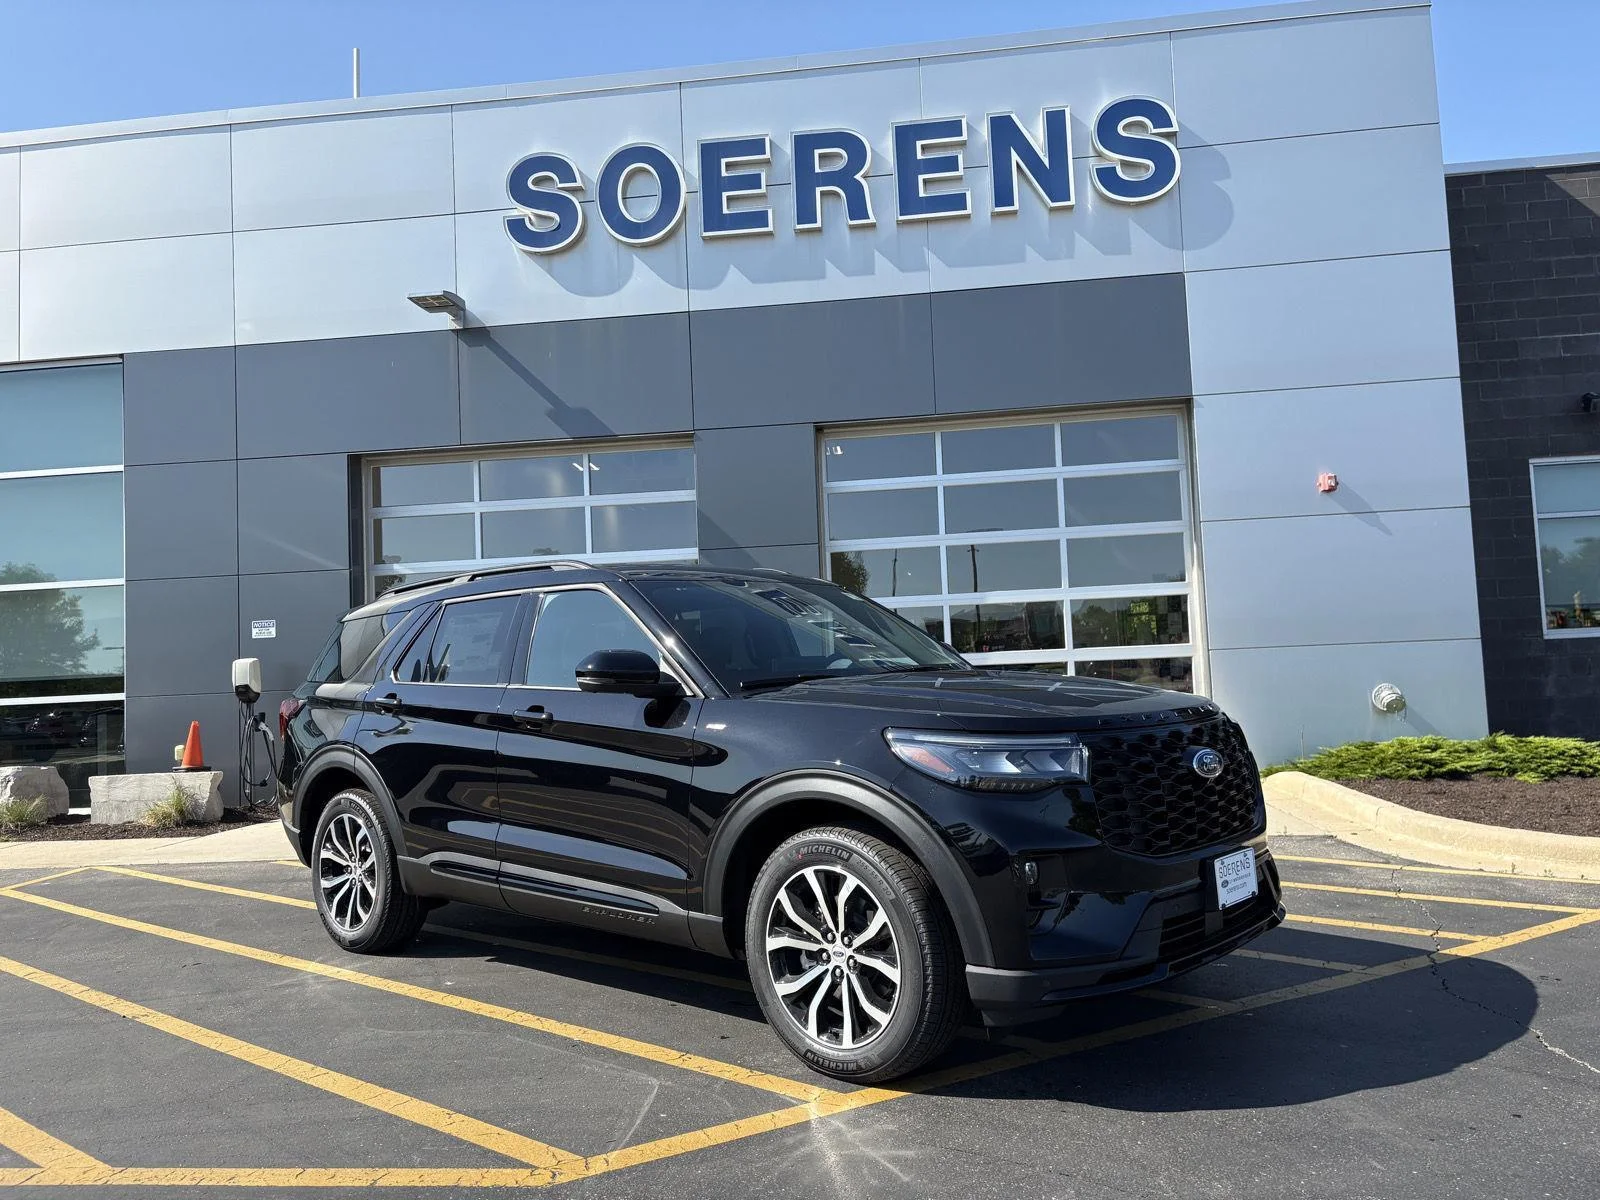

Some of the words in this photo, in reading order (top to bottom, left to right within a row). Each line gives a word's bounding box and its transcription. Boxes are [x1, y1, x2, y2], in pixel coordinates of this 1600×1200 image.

[502, 95, 1181, 255] SOERENS
[800, 845, 850, 860] MICHELIN
[1219, 857, 1251, 878] SOERENS
[806, 1052, 857, 1071] MICHELIN
